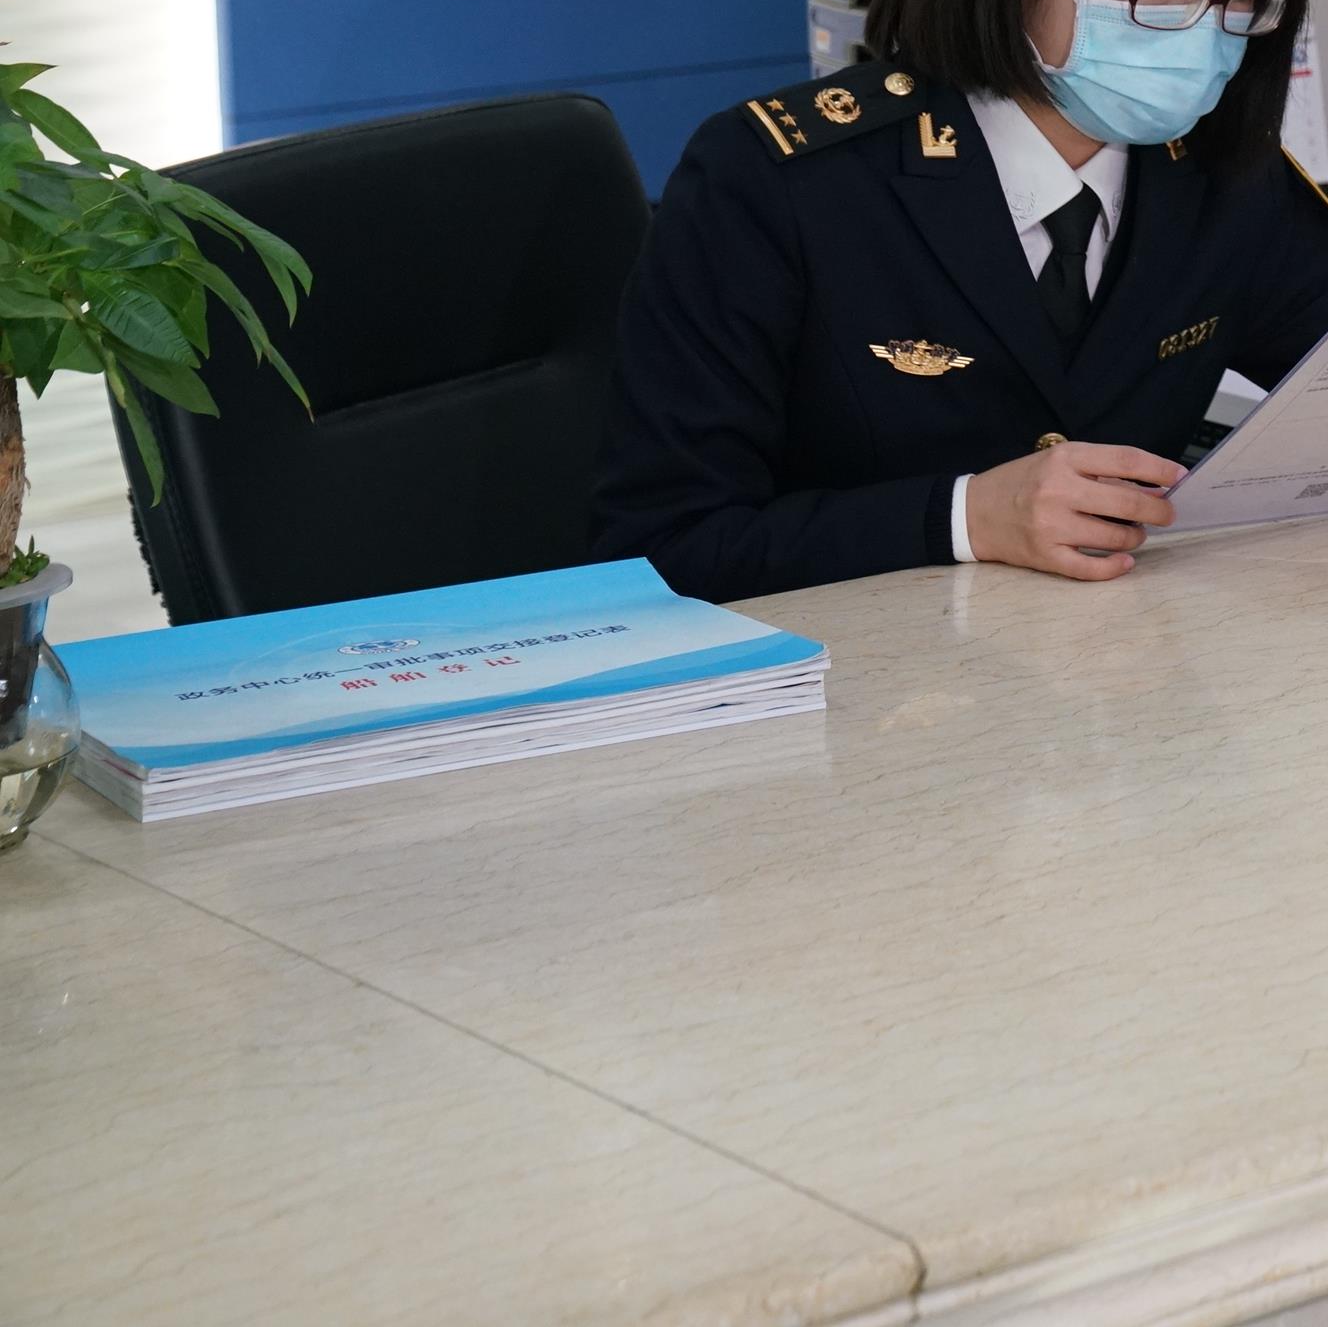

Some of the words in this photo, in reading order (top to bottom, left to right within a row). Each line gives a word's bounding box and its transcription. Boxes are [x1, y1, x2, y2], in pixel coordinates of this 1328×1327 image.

[174, 624, 631, 701] 政务中心统一审批事项交接登记表
[340, 655, 521, 691] 船舶登记
